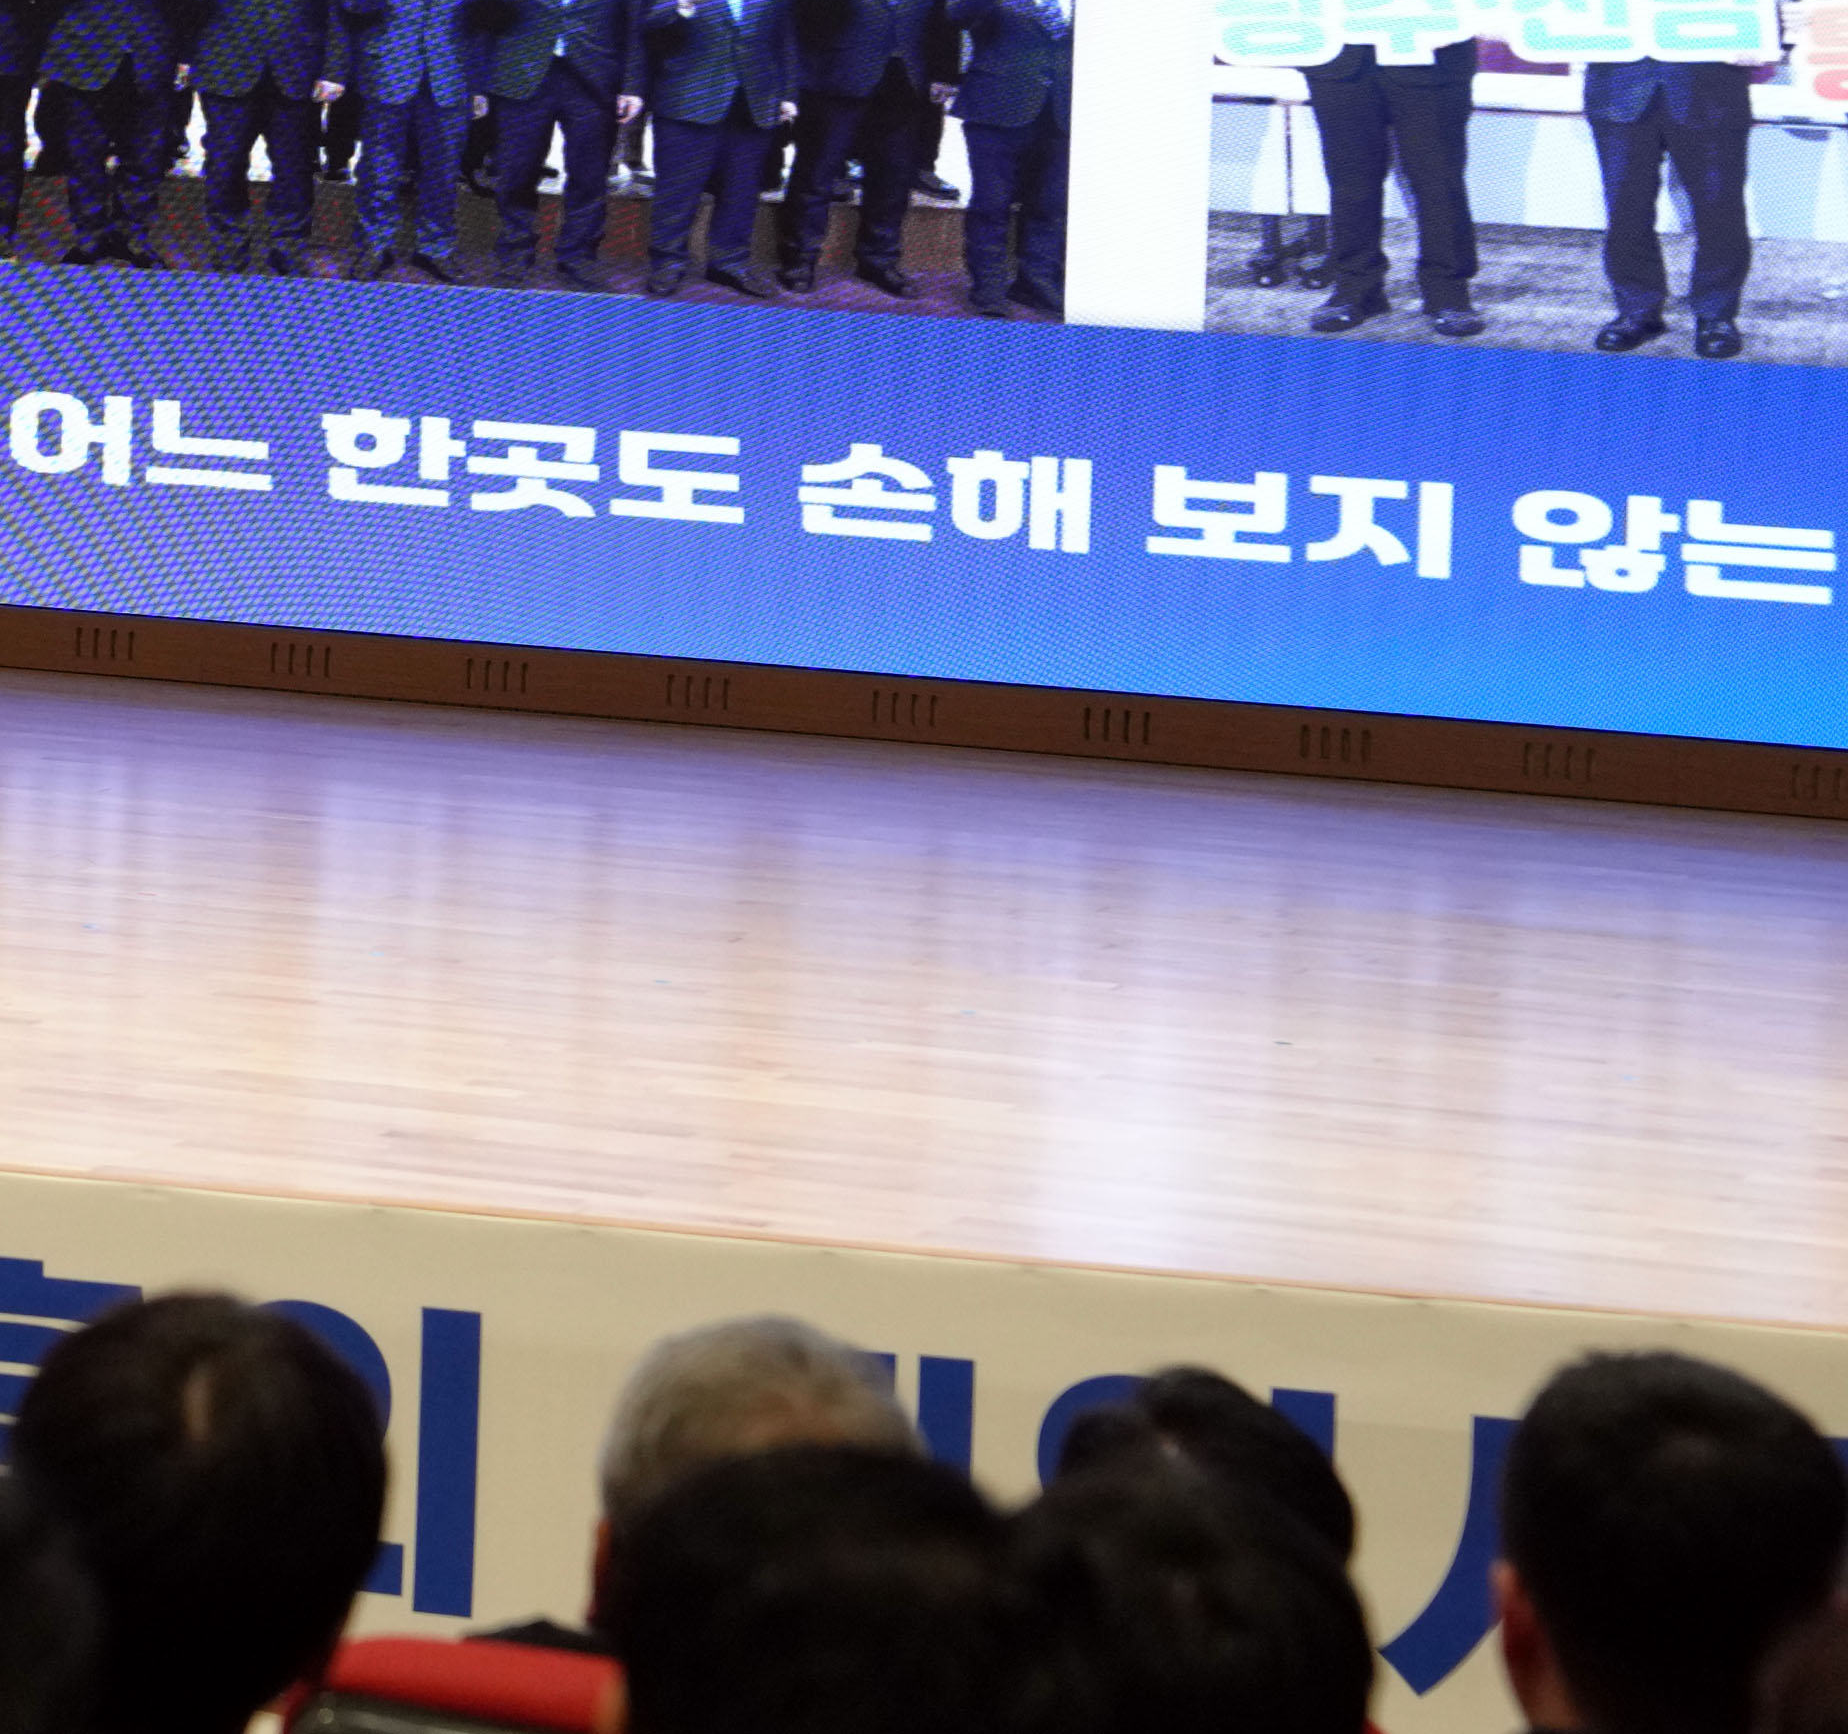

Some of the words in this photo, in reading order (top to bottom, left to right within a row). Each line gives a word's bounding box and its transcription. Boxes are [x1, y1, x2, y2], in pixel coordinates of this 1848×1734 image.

[9, 388, 273, 491] 어느
[321, 408, 746, 524] 한곳도
[798, 442, 1094, 554] 손해
[1146, 466, 1454, 580] 보지
[1510, 488, 1839, 606] 않는
